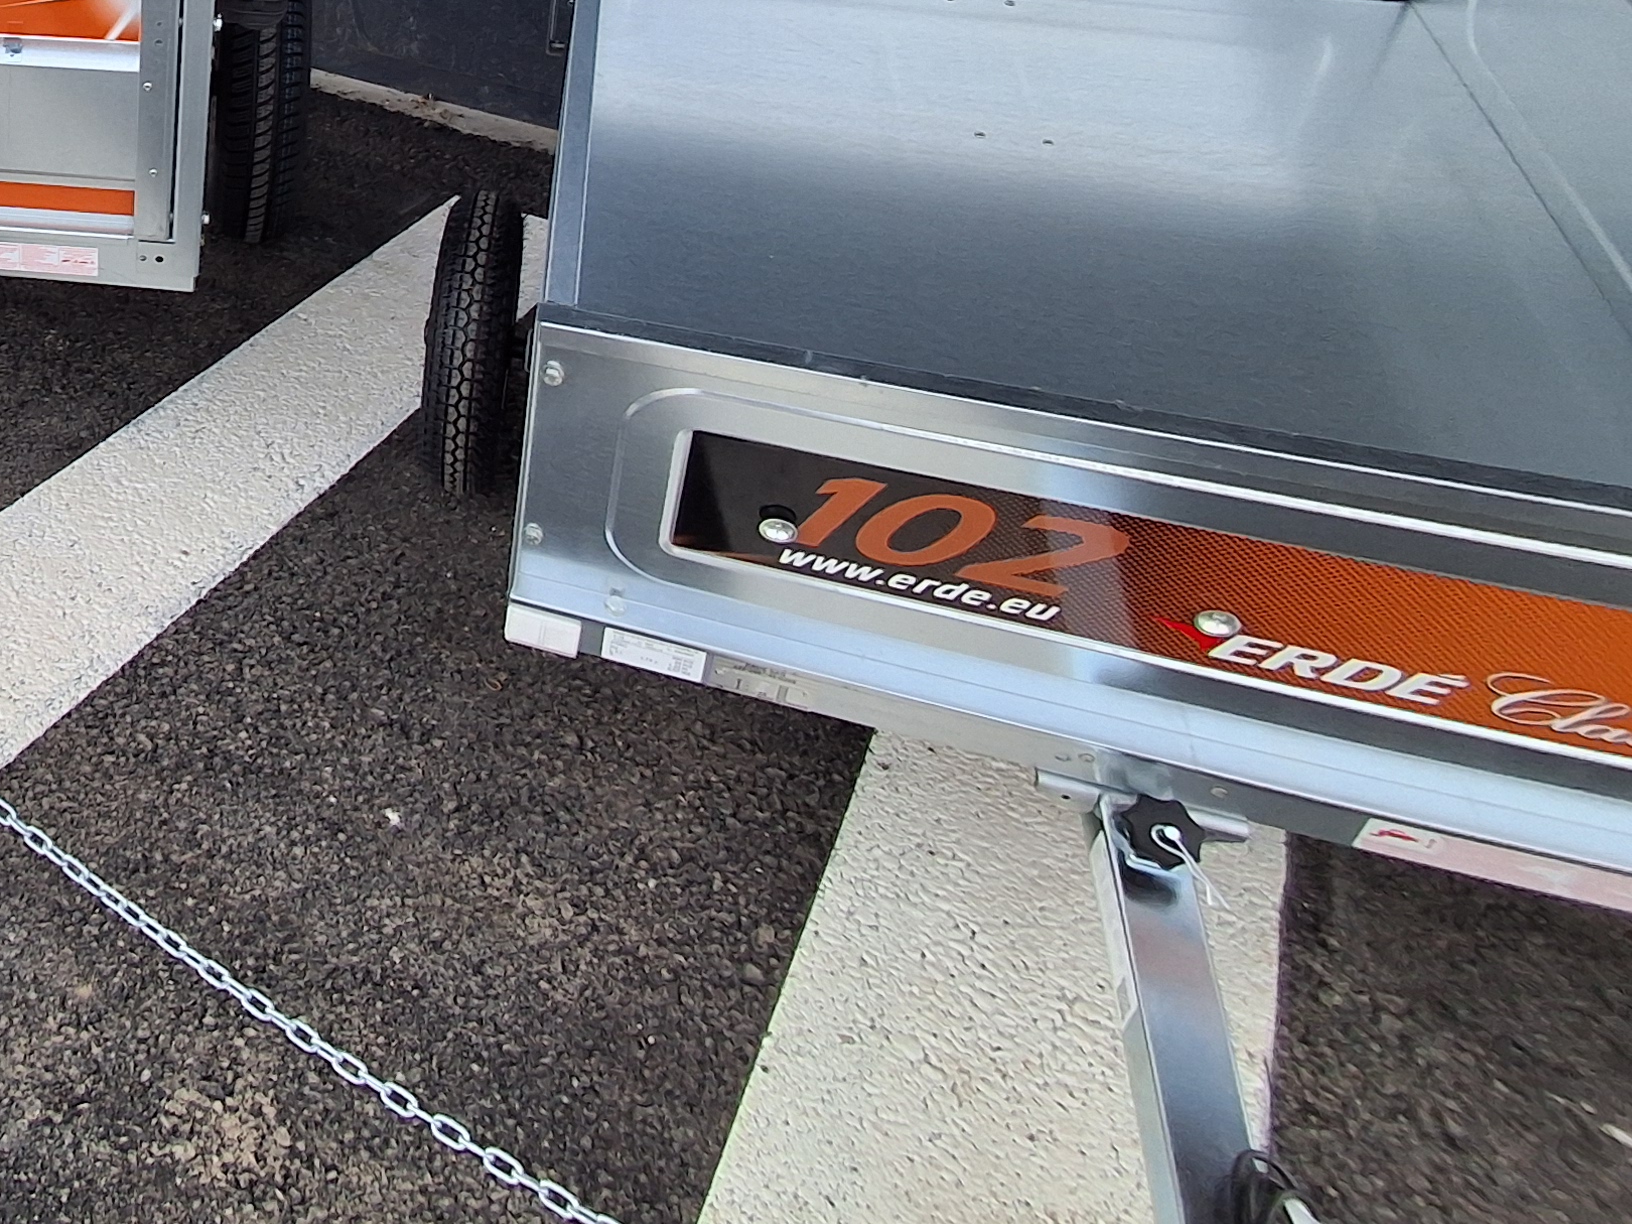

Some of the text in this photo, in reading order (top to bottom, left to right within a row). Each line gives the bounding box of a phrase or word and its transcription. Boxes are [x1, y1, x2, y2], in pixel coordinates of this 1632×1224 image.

[794, 477, 1131, 598] 102
[778, 548, 1062, 623] www.erde.eu
[1486, 672, 1632, 746] Cla
